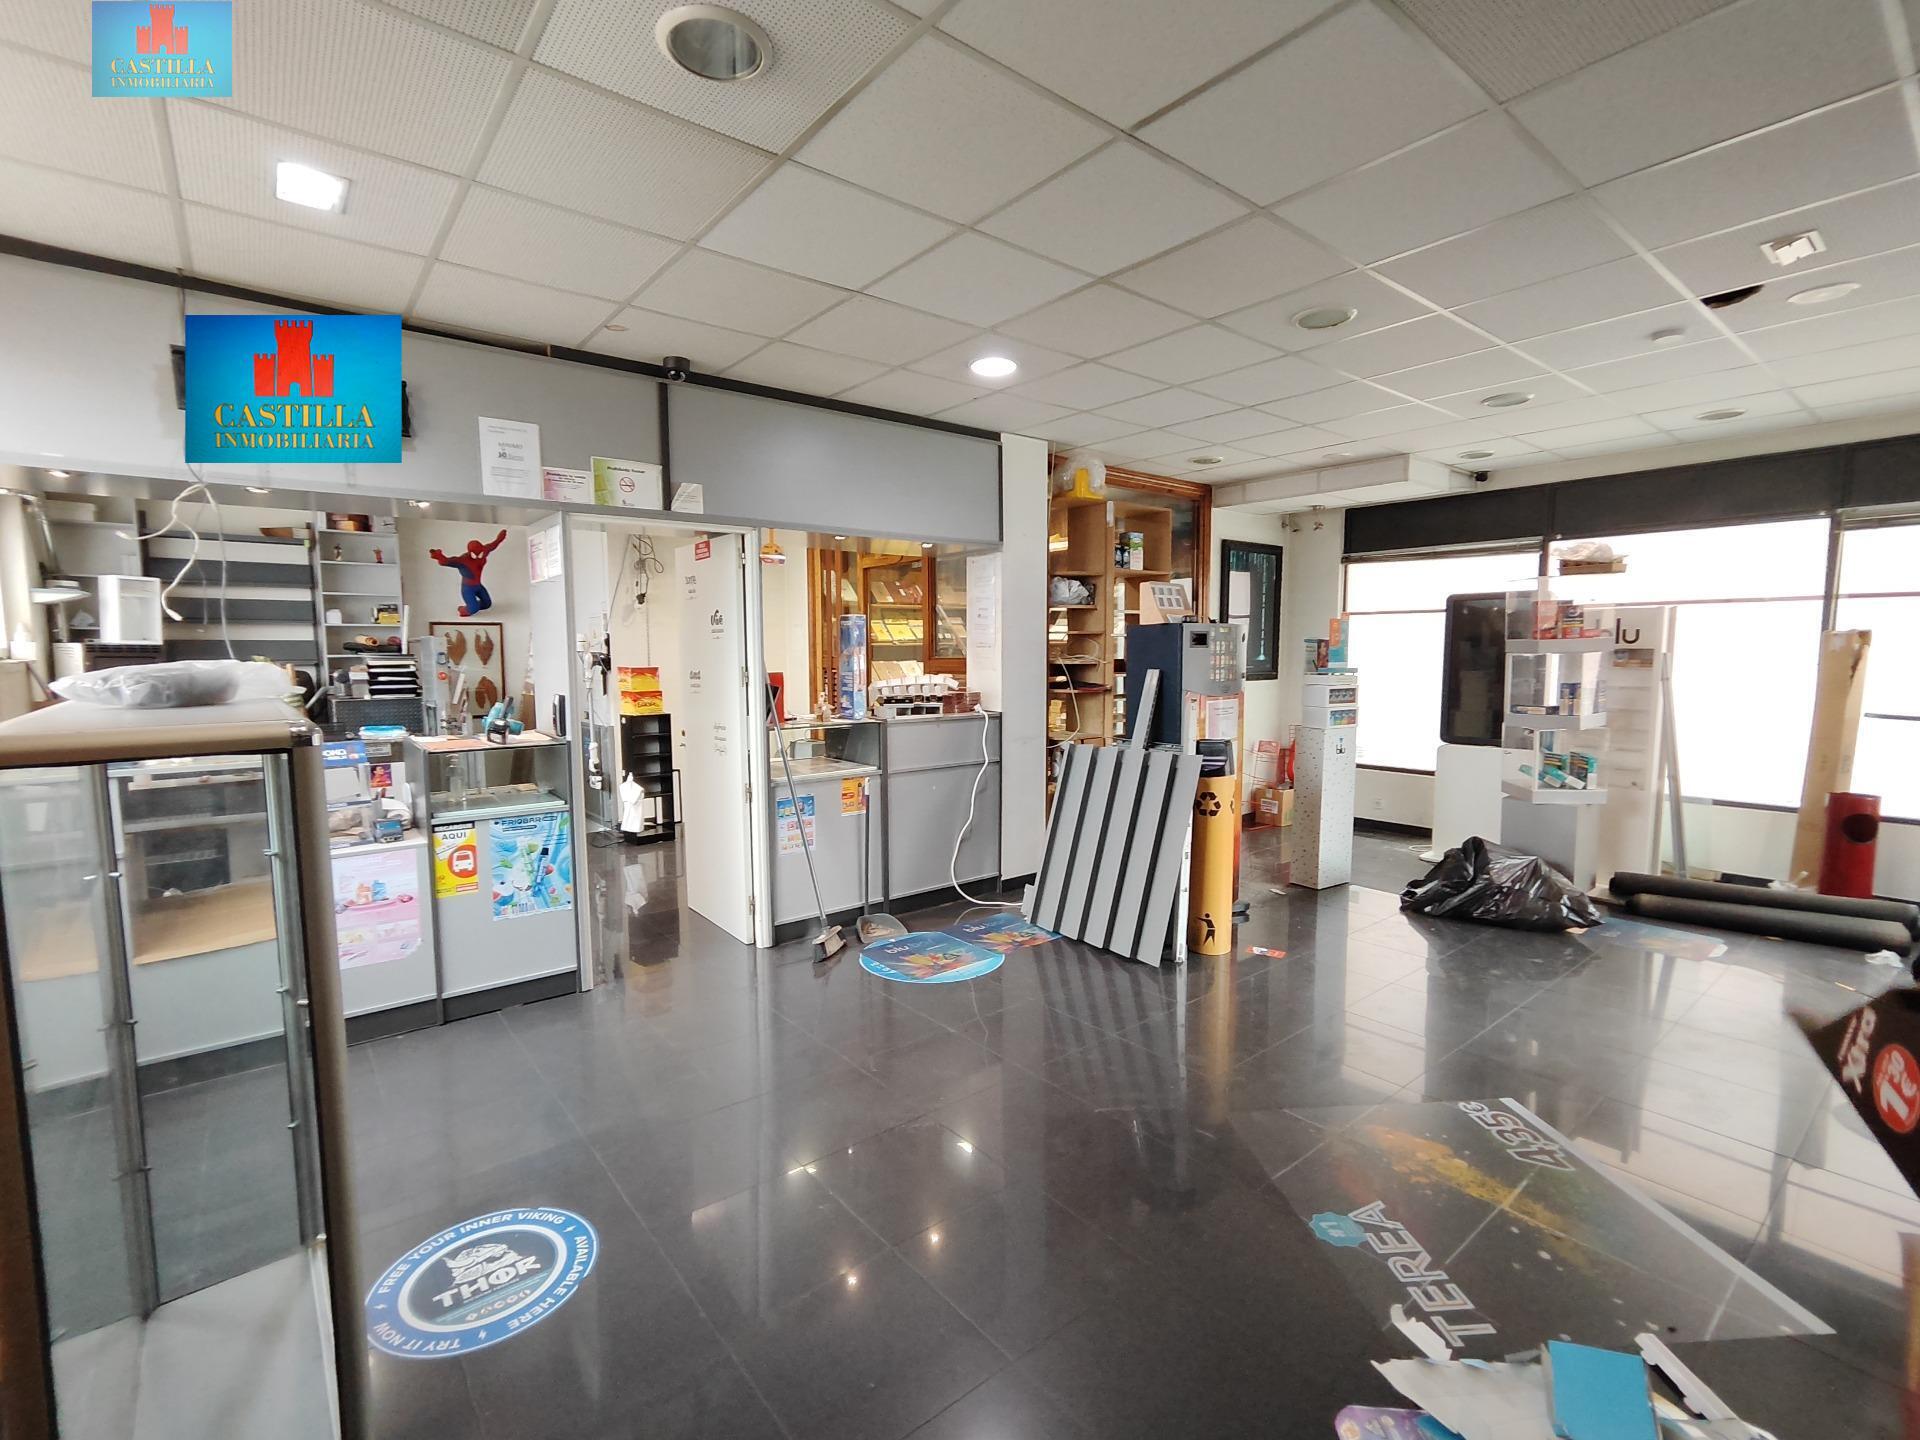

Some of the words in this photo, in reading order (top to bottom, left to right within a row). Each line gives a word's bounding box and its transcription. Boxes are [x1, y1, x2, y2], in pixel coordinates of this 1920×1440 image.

[377, 1262, 412, 1294] FREE
[406, 1231, 457, 1261] YOUR
[459, 1213, 514, 1234] INNER
[517, 1211, 567, 1225] VIKING
[552, 1235, 589, 1297] AVAILABLE
[1348, 1200, 1498, 1348] TEREA
[431, 1255, 542, 1309] THOR
[373, 1320, 407, 1347] NOW
[506, 1297, 556, 1330] HERE
[402, 1339, 424, 1351] IT
[421, 1338, 461, 1352] TRY
